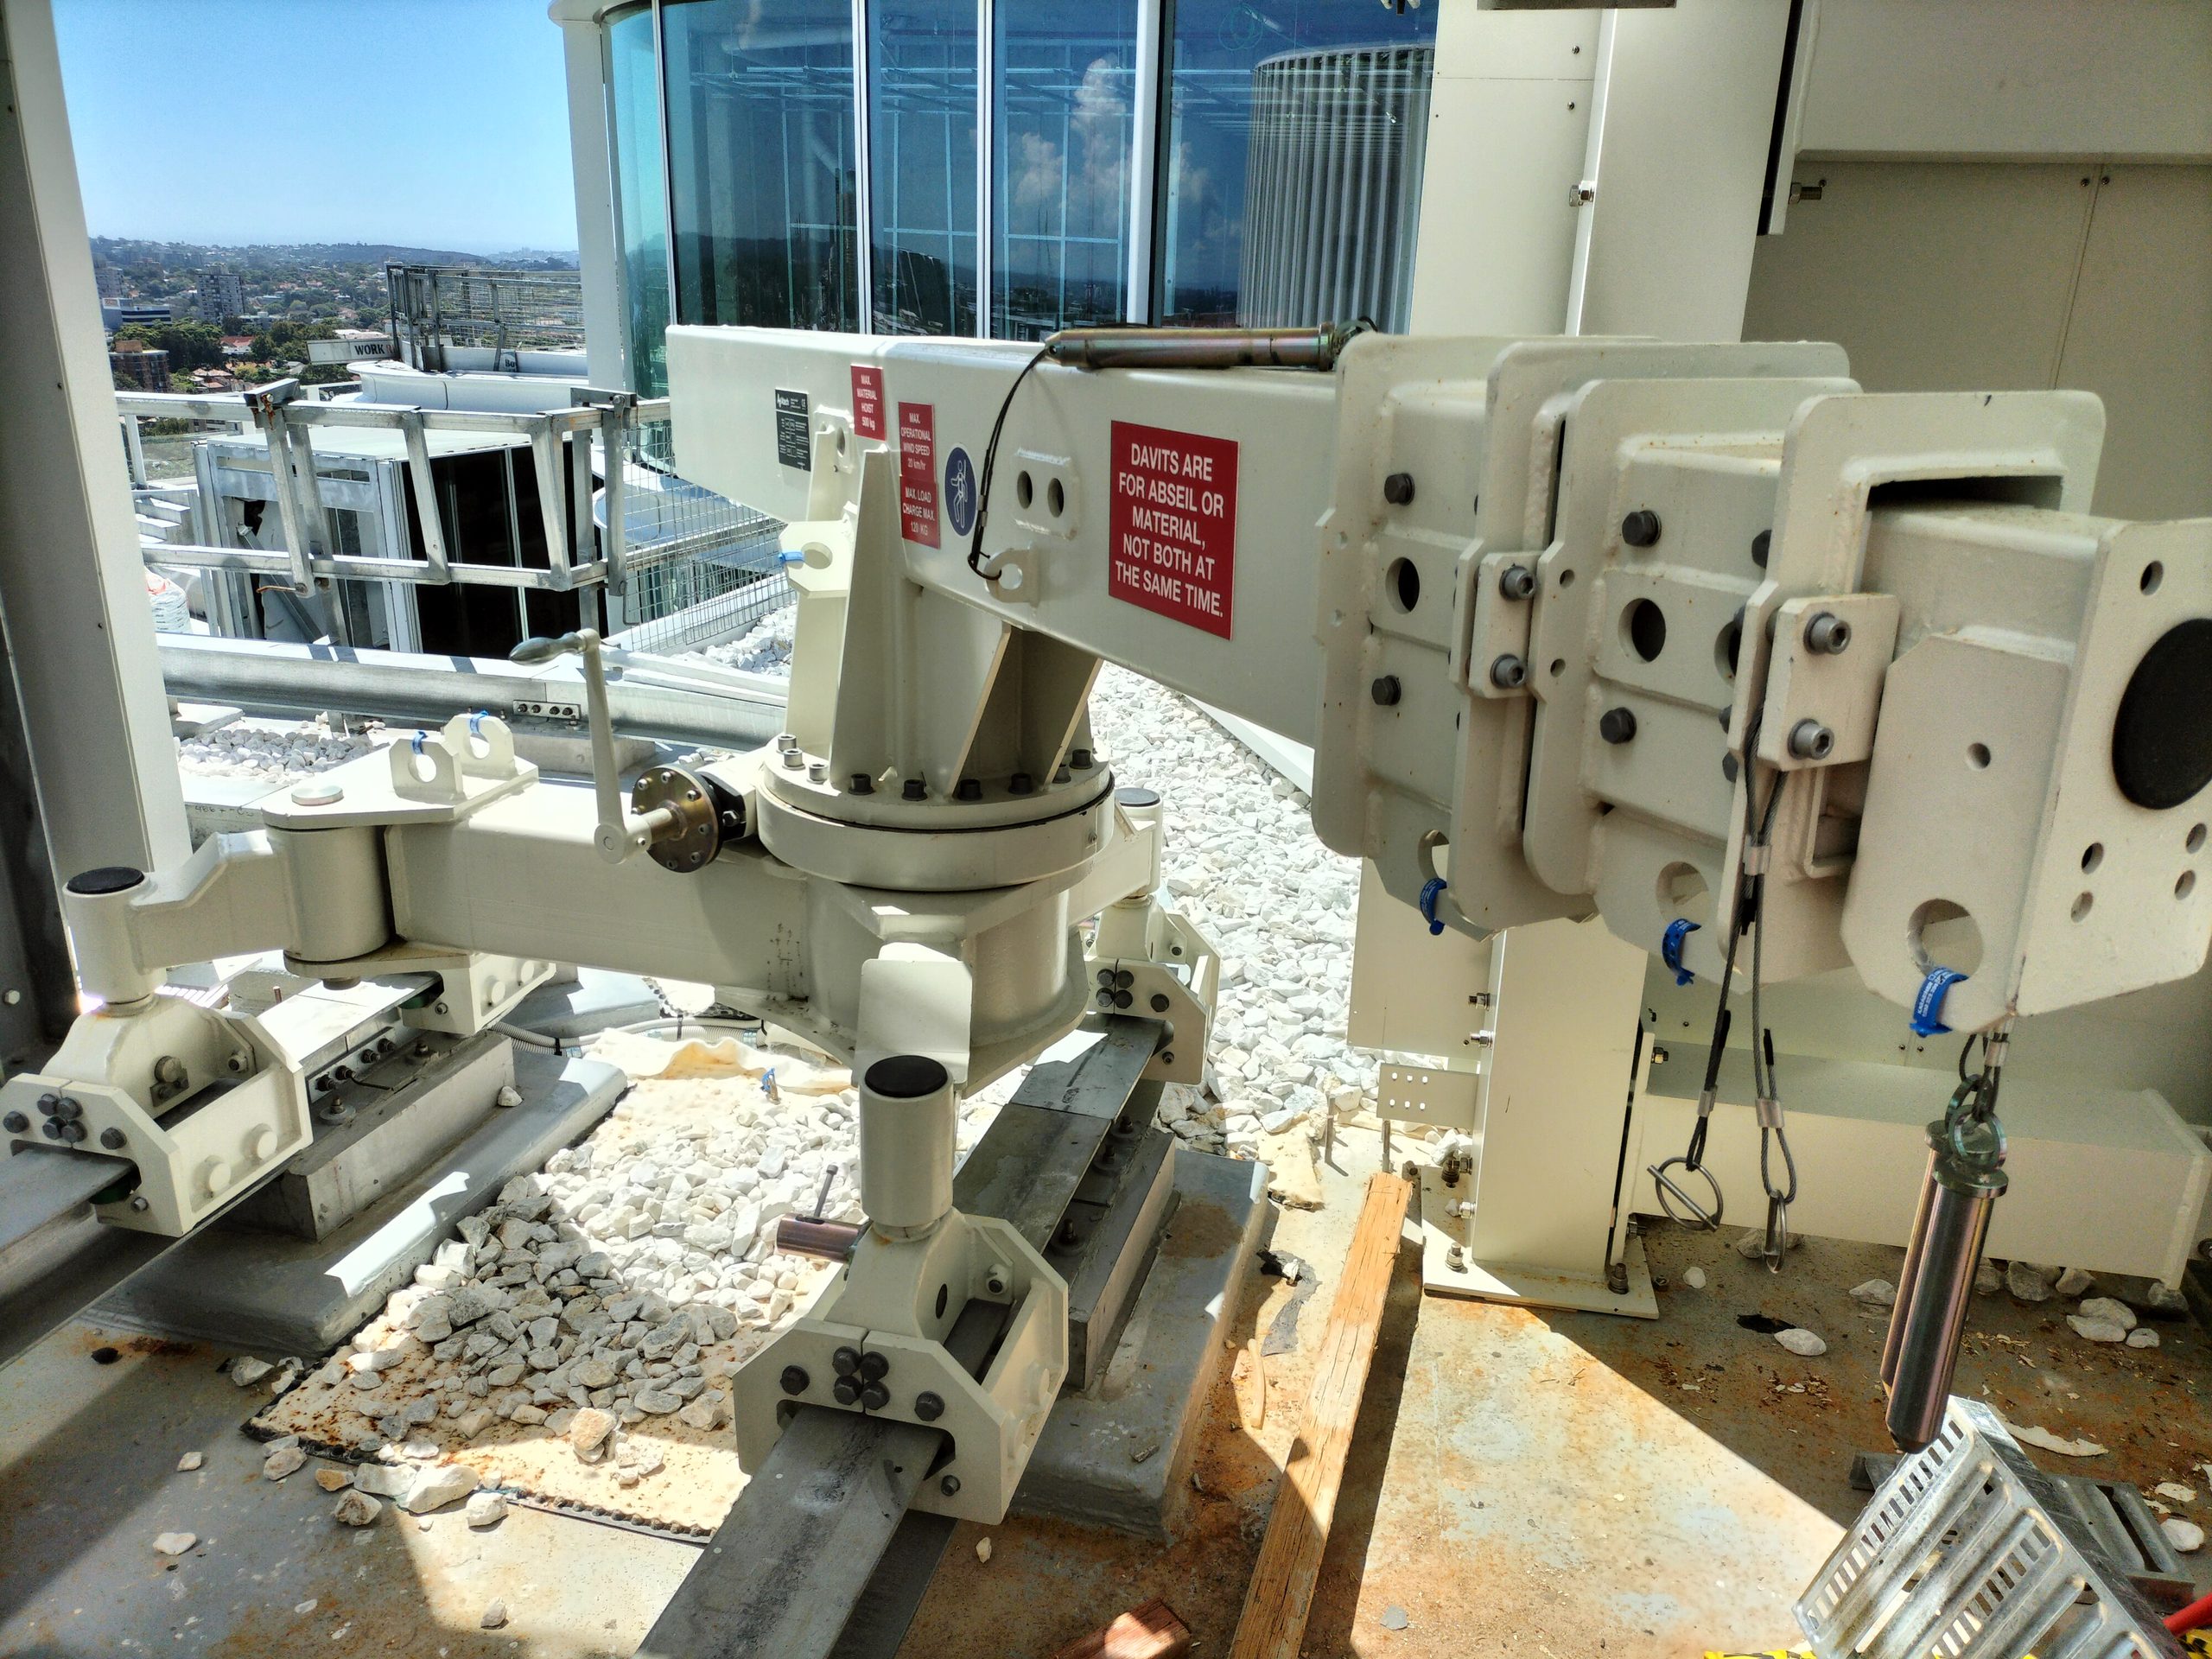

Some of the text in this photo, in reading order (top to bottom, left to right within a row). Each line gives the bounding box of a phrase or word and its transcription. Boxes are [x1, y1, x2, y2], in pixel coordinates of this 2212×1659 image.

[354, 344, 385, 355] WORK
[856, 387, 878, 401] MATERIAL
[861, 403, 874, 414] HOIST
[900, 427, 931, 442] OPERATIONAL
[903, 442, 930, 456] WIND SPEED
[907, 458, 926, 471] 20 km/hr
[1131, 442, 1213, 482] DAVITS ARE
[905, 486, 931, 503] MAX. LOAD
[1119, 472, 1224, 518] FOR ABSEIL OR
[902, 502, 935, 521] CHARGE MAX.
[920, 524, 928, 536] KG
[1132, 505, 1205, 550] MATERIAL,
[1123, 532, 1215, 581] NOT BOTH AT
[1116, 560, 1224, 618] THE SAME TIME.
